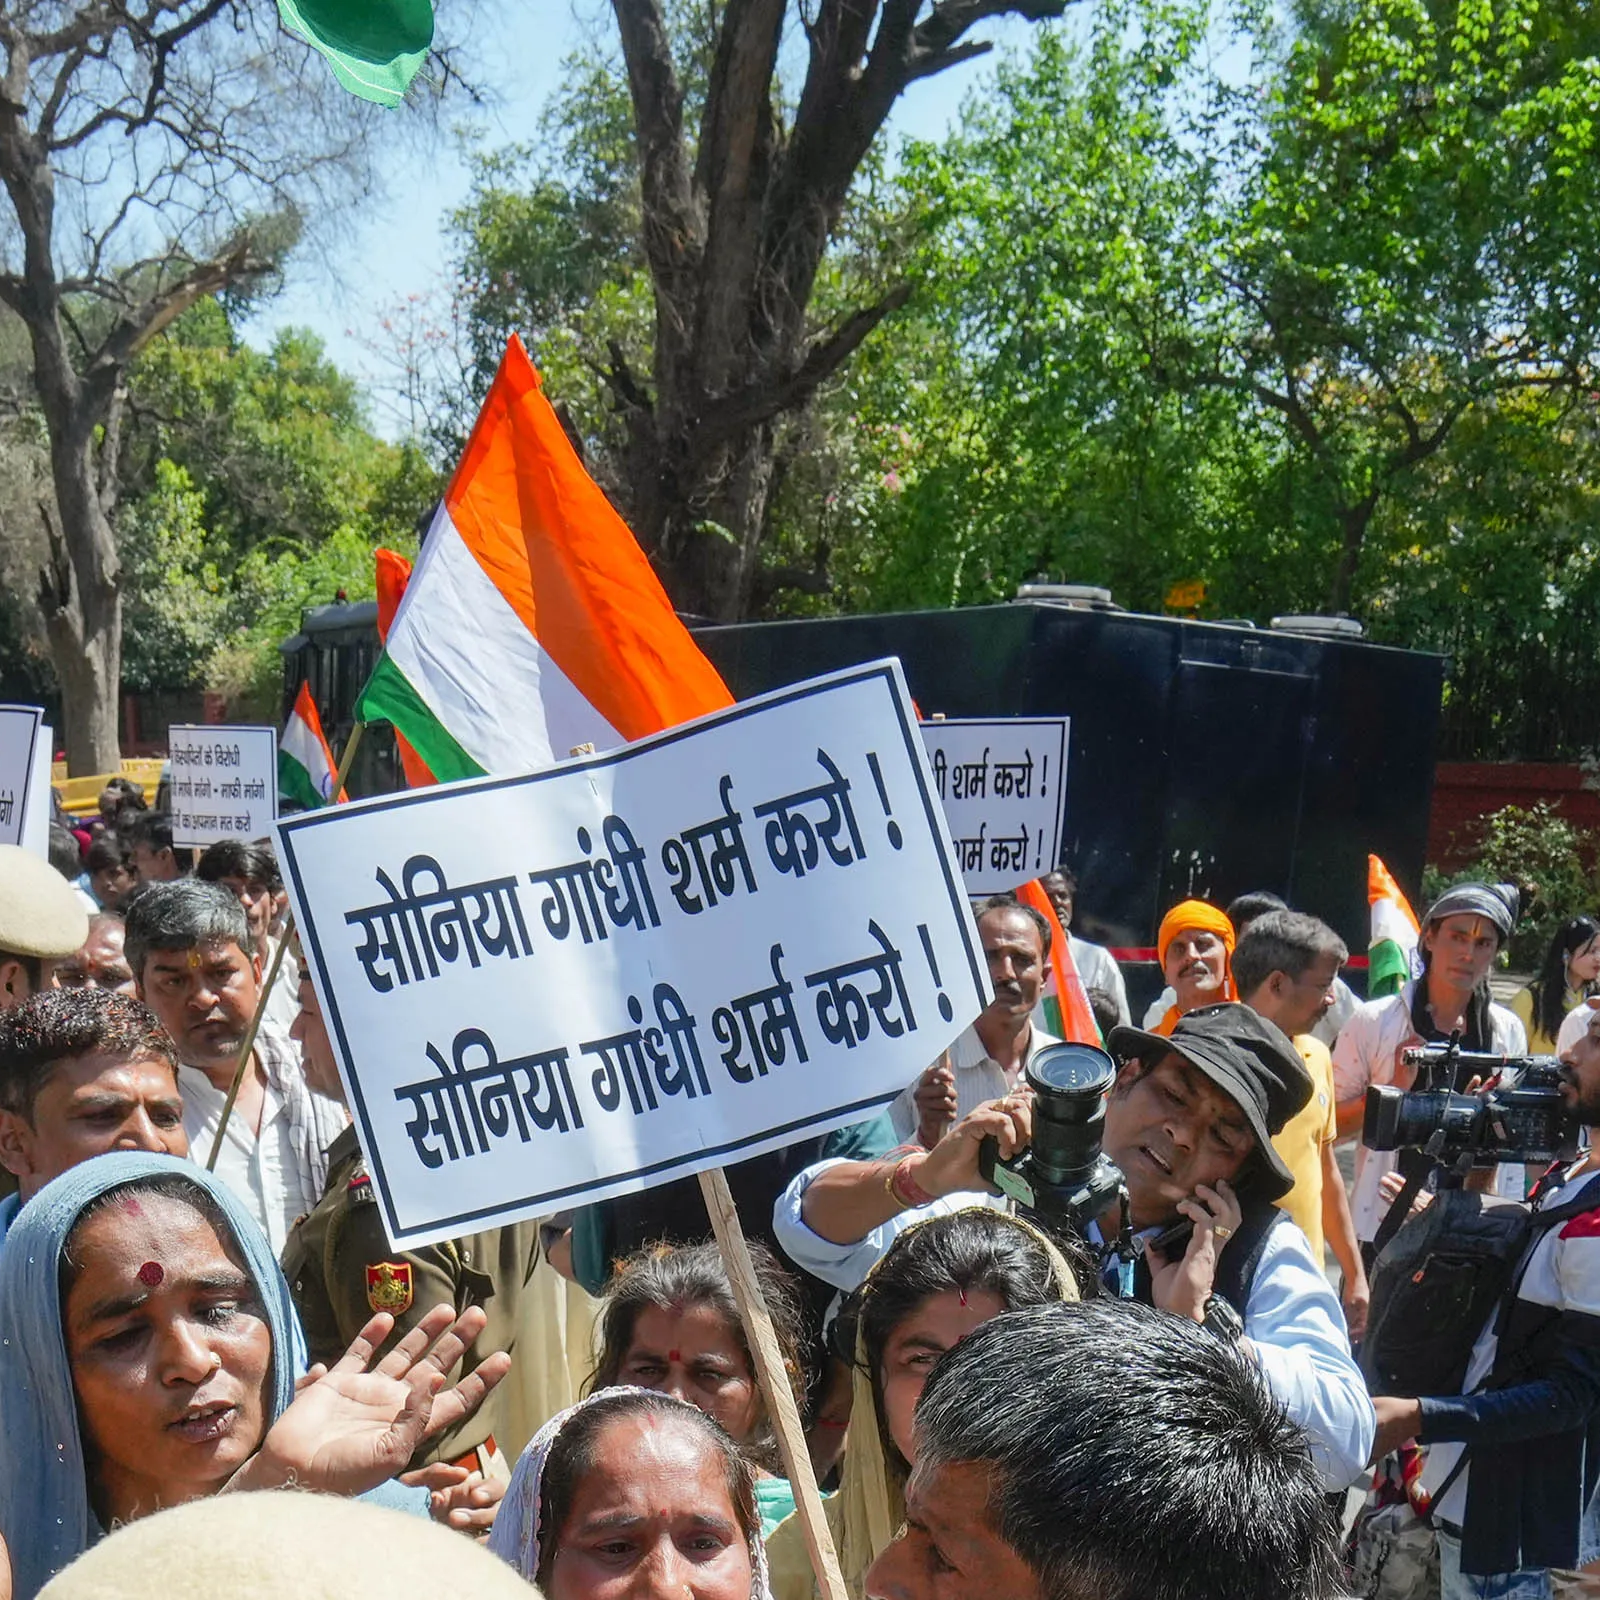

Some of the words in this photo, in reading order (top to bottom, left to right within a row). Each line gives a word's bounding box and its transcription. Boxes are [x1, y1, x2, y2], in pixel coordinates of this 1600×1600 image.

[214, 743, 240, 767] विरोधी
[952, 747, 990, 800] शर्म
[993, 748, 1034, 799] करो
[234, 809, 251, 832] करो
[344, 855, 533, 992] सोनिया
[529, 816, 662, 943] गांधी
[661, 775, 758, 915] शर्म
[753, 748, 867, 877] करो
[990, 822, 1029, 872] करो
[394, 1029, 585, 1168] सोनिया
[579, 983, 712, 1114] गांधी
[712, 944, 808, 1083] शर्म
[804, 919, 918, 1049] करो
